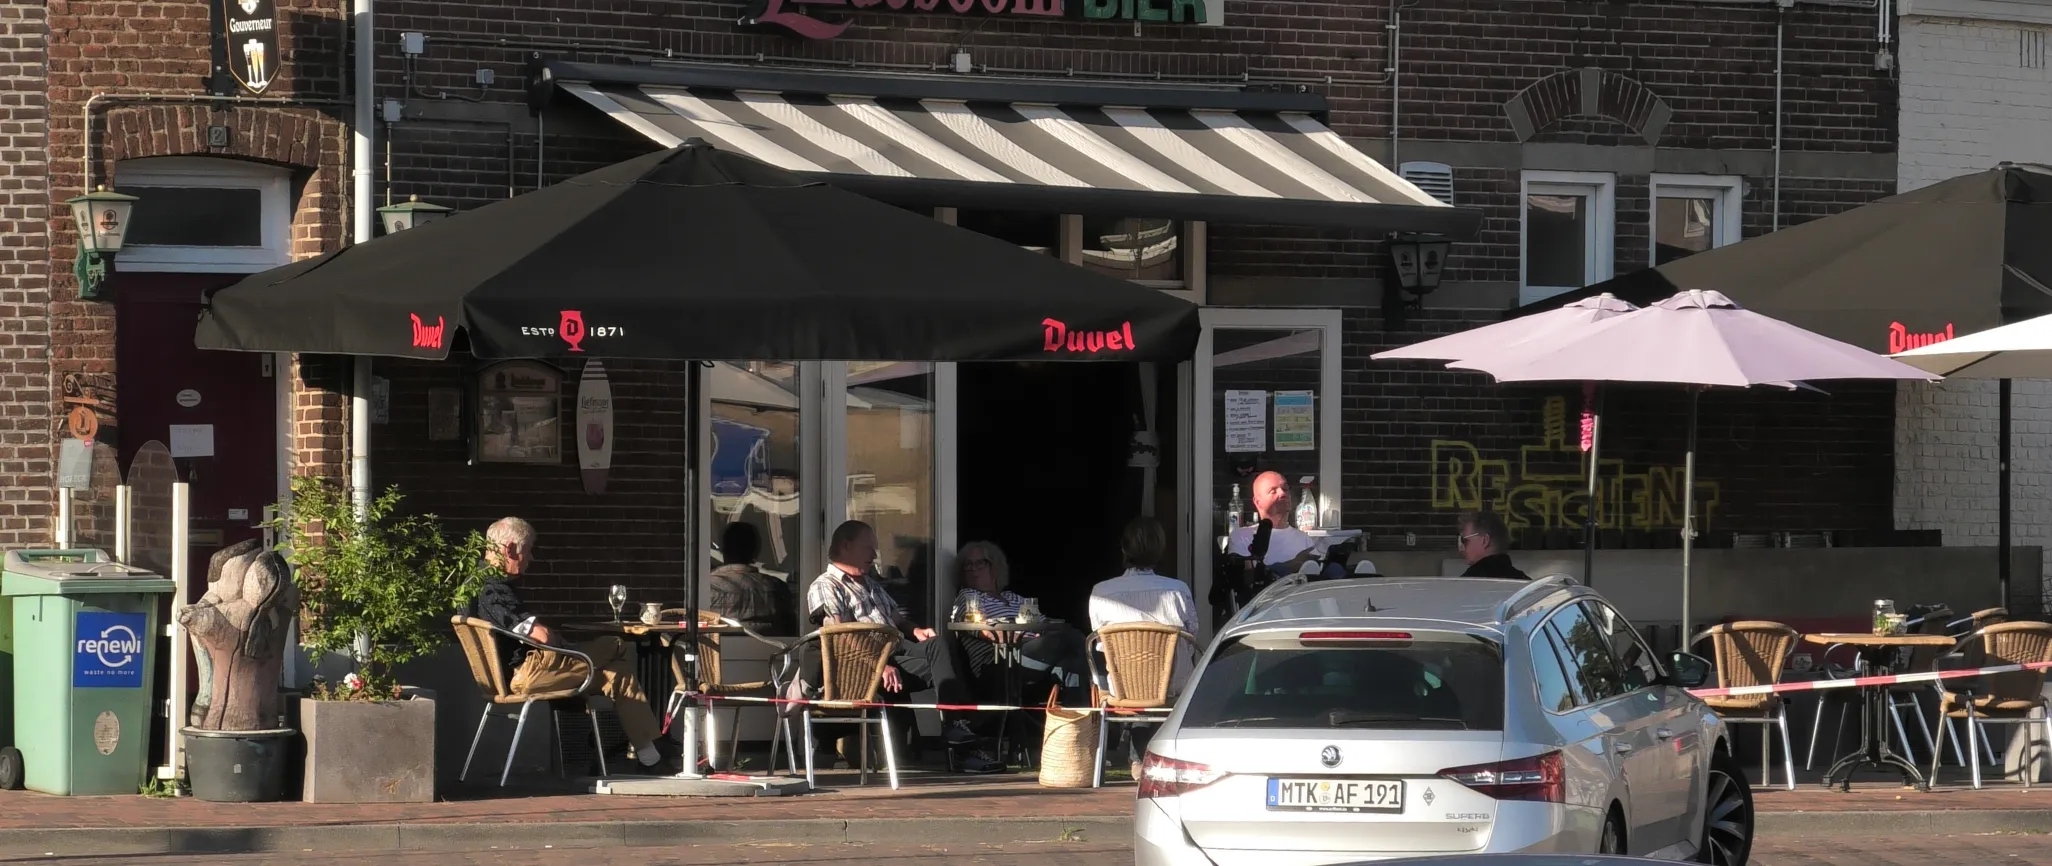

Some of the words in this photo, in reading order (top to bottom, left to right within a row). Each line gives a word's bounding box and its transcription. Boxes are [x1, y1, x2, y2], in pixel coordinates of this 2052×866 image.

[229, 18, 272, 33] Gouverneur
[212, 129, 222, 143] 2
[410, 312, 444, 349] Duvel
[590, 327, 624, 337] 1871
[1041, 317, 1136, 352] Duvel
[1281, 781, 1318, 804] MTK
[1334, 783, 1359, 804] AF
[1363, 784, 1400, 805] 191
[1445, 812, 1490, 820] SUPERB
